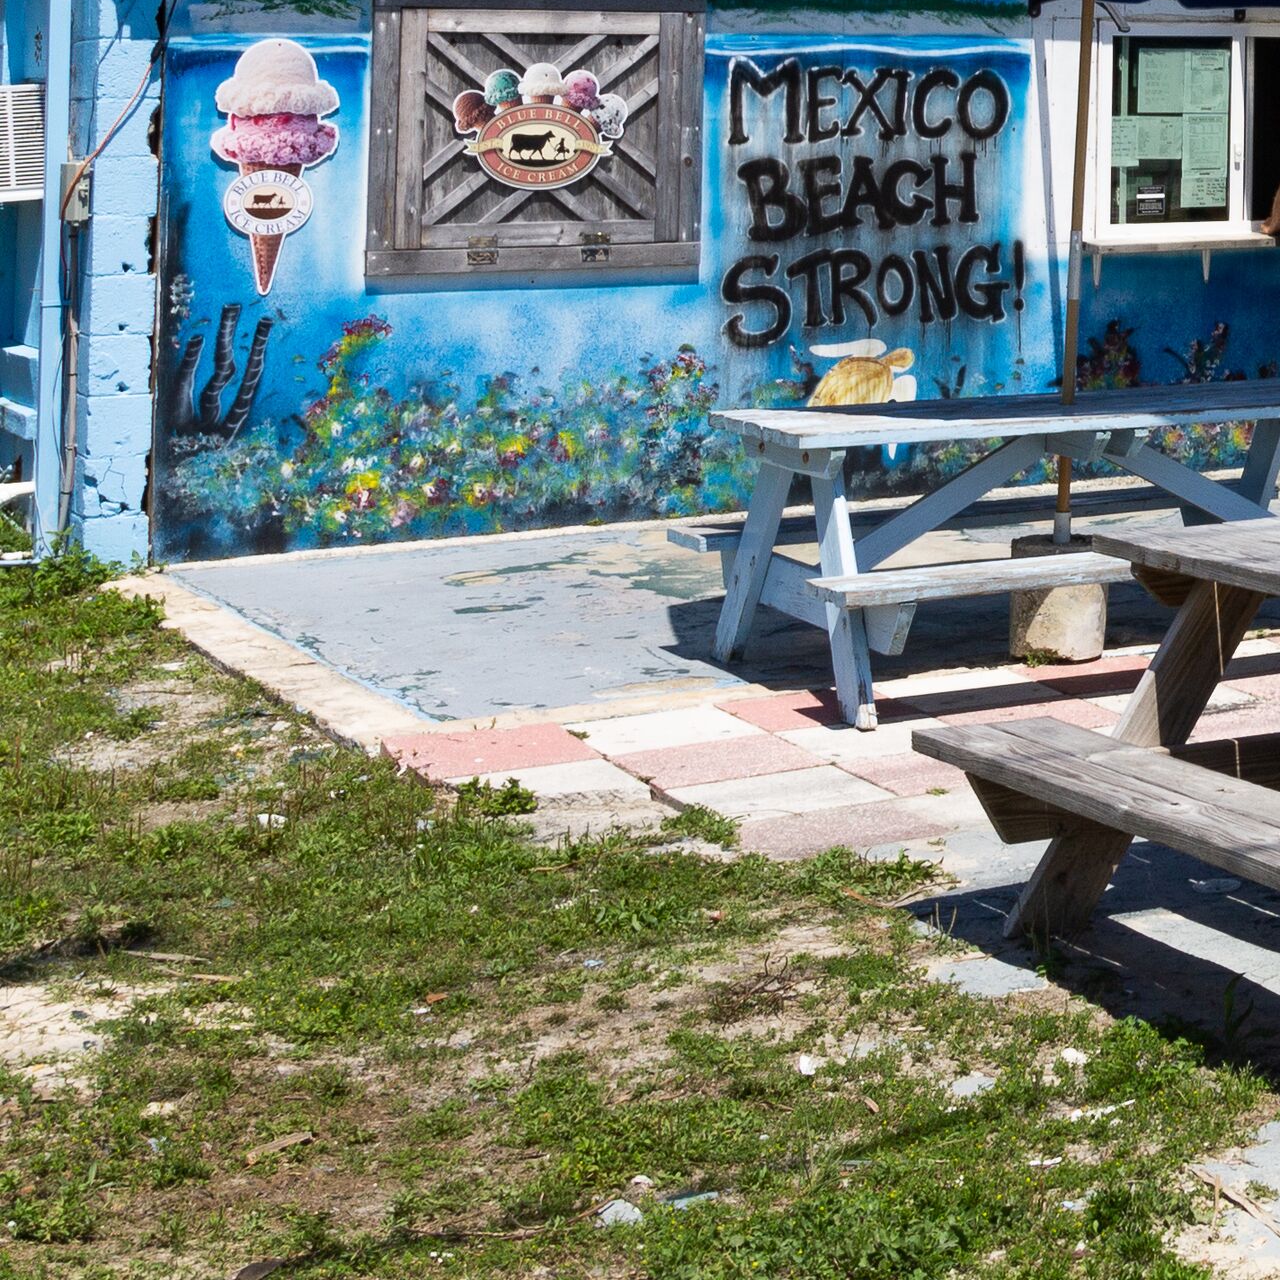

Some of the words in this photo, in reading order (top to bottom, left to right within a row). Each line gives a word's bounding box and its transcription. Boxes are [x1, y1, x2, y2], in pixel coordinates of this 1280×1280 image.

[728, 56, 1011, 145] MEXICO
[496, 110, 537, 130] BLUE
[545, 109, 582, 130] BELL
[232, 173, 269, 196] BLUE
[273, 172, 304, 192] BELL
[497, 162, 520, 178] ICE
[527, 163, 579, 182] CREAM
[737, 152, 981, 242] BEACH
[231, 209, 251, 228] ICE
[254, 209, 306, 234] CREAM
[721, 239, 1026, 348] STRONG!
